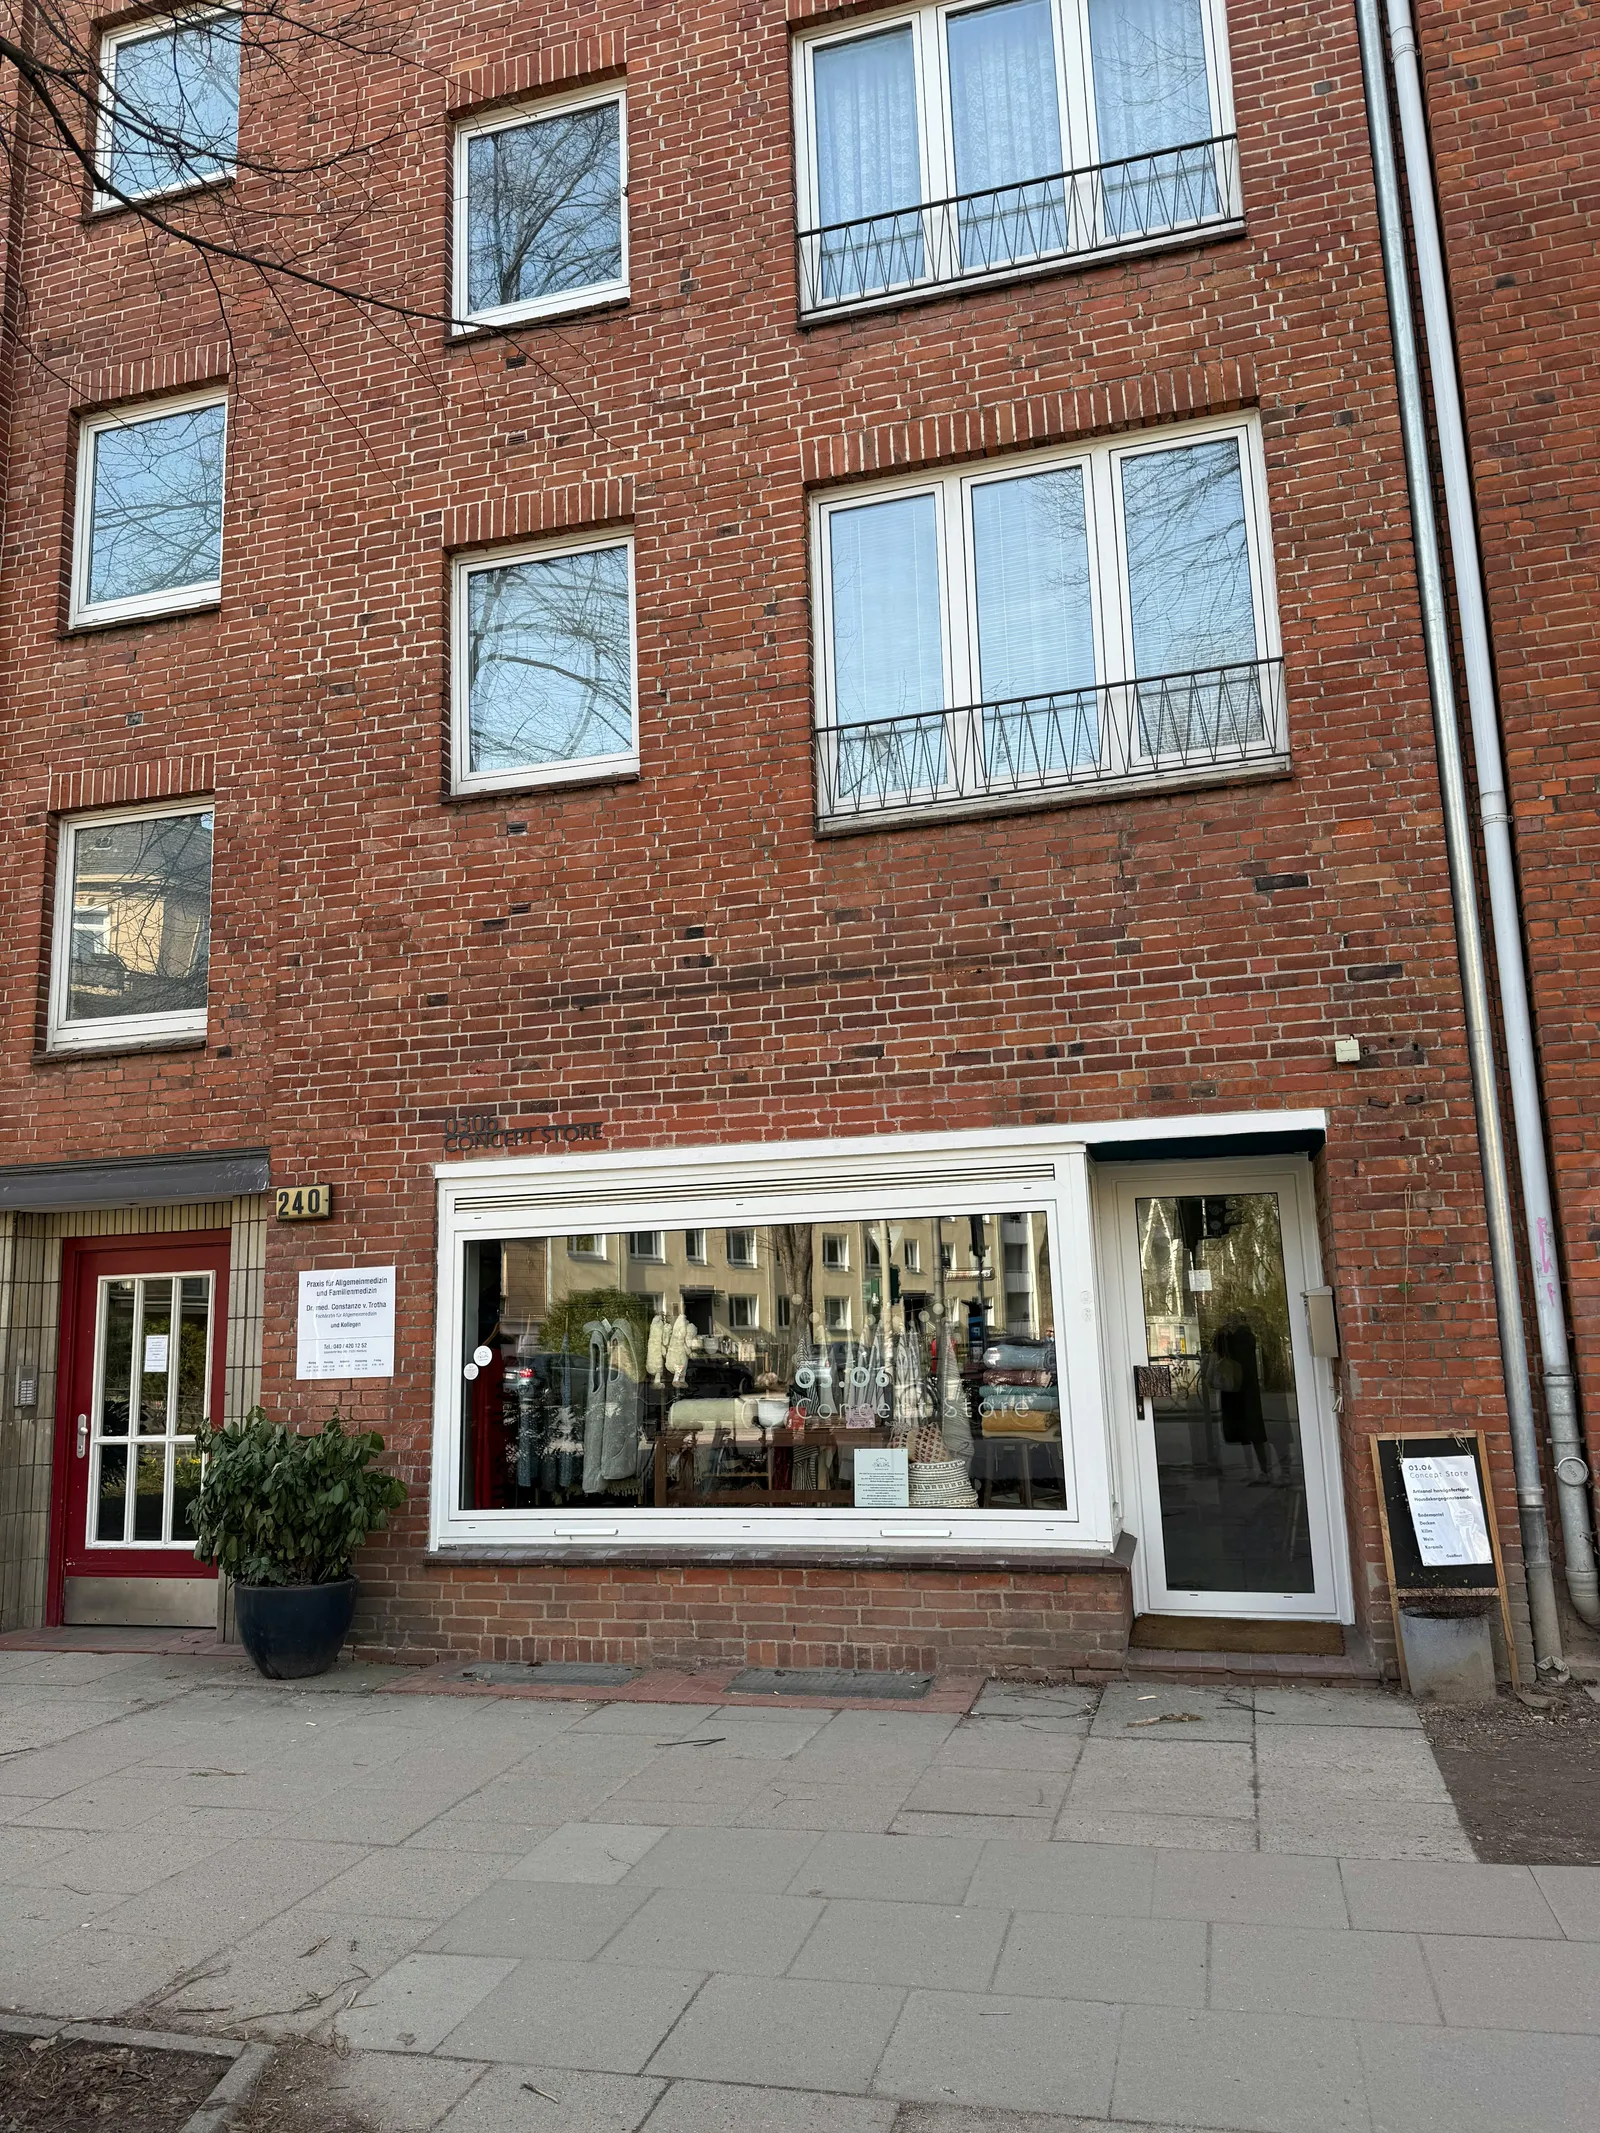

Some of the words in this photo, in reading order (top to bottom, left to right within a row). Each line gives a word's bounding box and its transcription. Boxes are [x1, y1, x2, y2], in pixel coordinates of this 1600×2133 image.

[444, 1114, 498, 1135] 0306
[444, 1128, 536, 1152] CONCEPT
[542, 1122, 603, 1143] STORE
[279, 1189, 320, 1215] 240
[329, 1287, 377, 1296] Familienmedizin
[335, 1277, 387, 1287] Allgemeinmedizin
[944, 1397, 1030, 1418] Store
